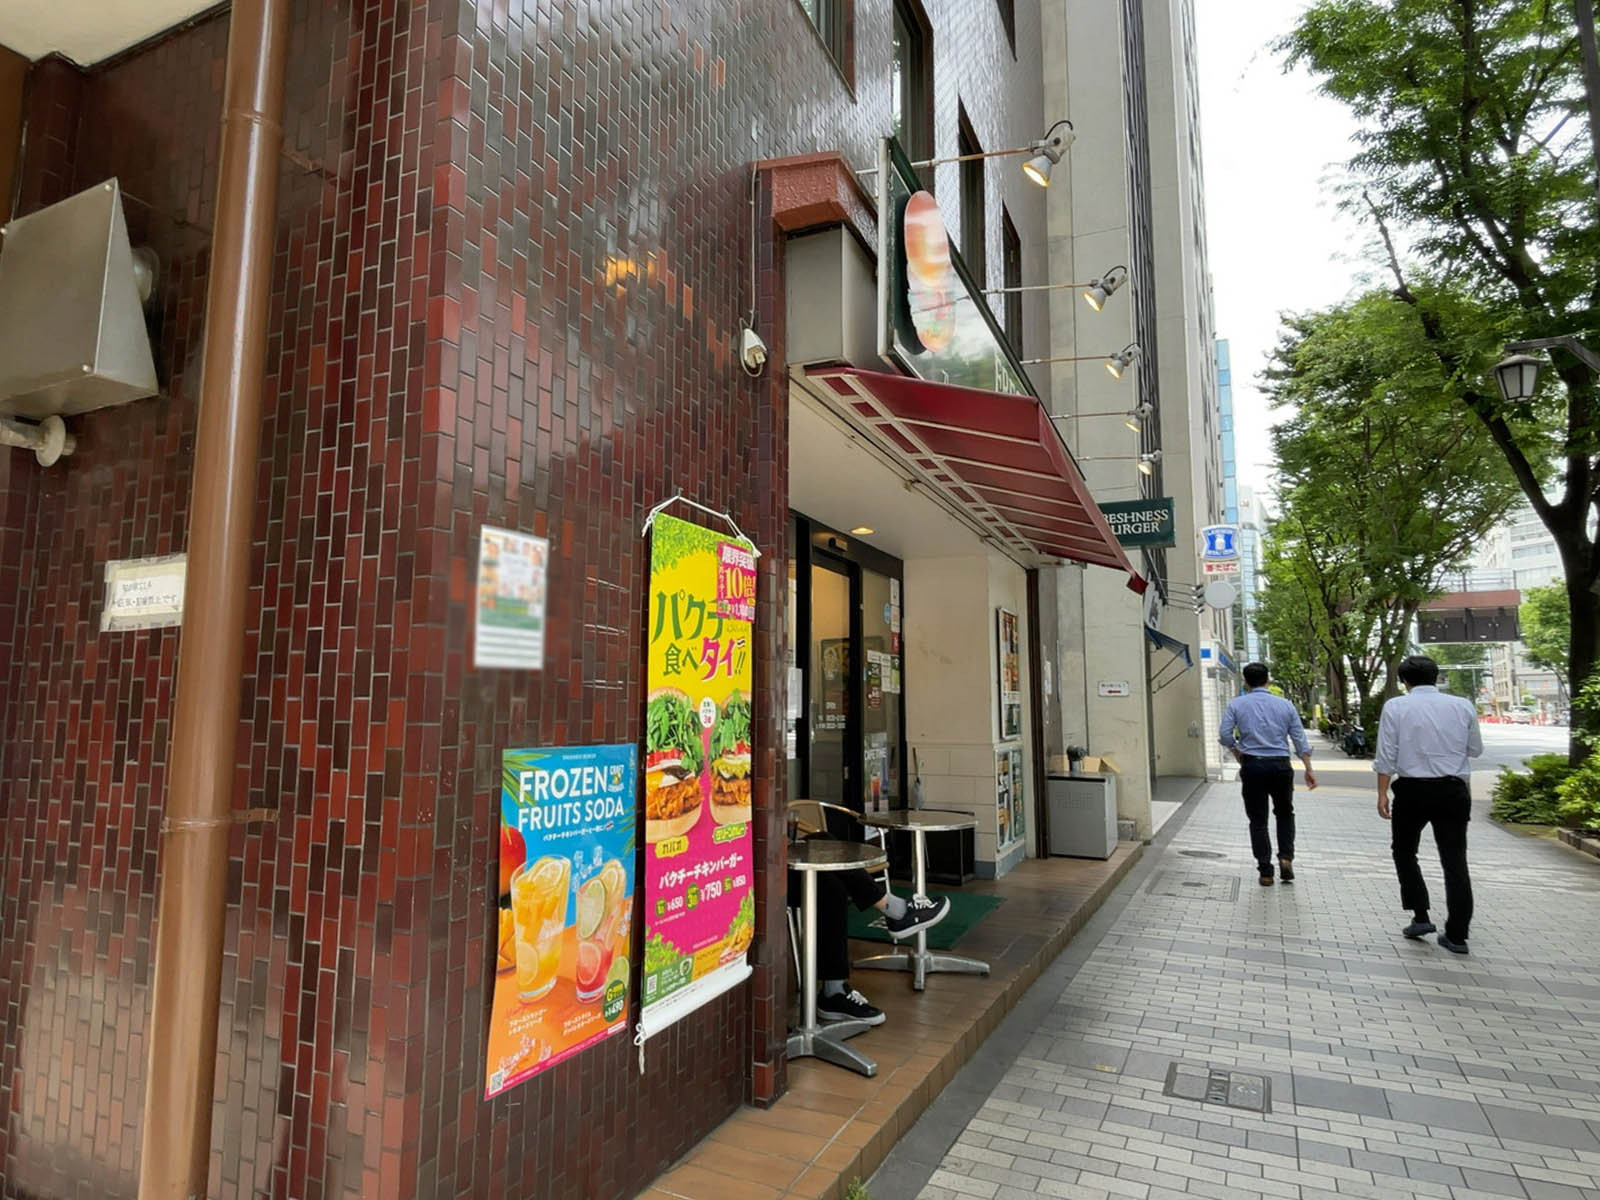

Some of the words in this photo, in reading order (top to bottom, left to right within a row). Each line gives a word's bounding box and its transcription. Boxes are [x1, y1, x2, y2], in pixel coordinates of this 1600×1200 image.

[1103, 508, 1169, 525] RESHNESS
[1111, 521, 1160, 536] URGER
[519, 765, 608, 803] FROZEN
[518, 802, 581, 833] FRUITS
[584, 796, 625, 822] SODA
[658, 852, 744, 889] パクチーチキンバーガー
[700, 880, 722, 902] ¥750
